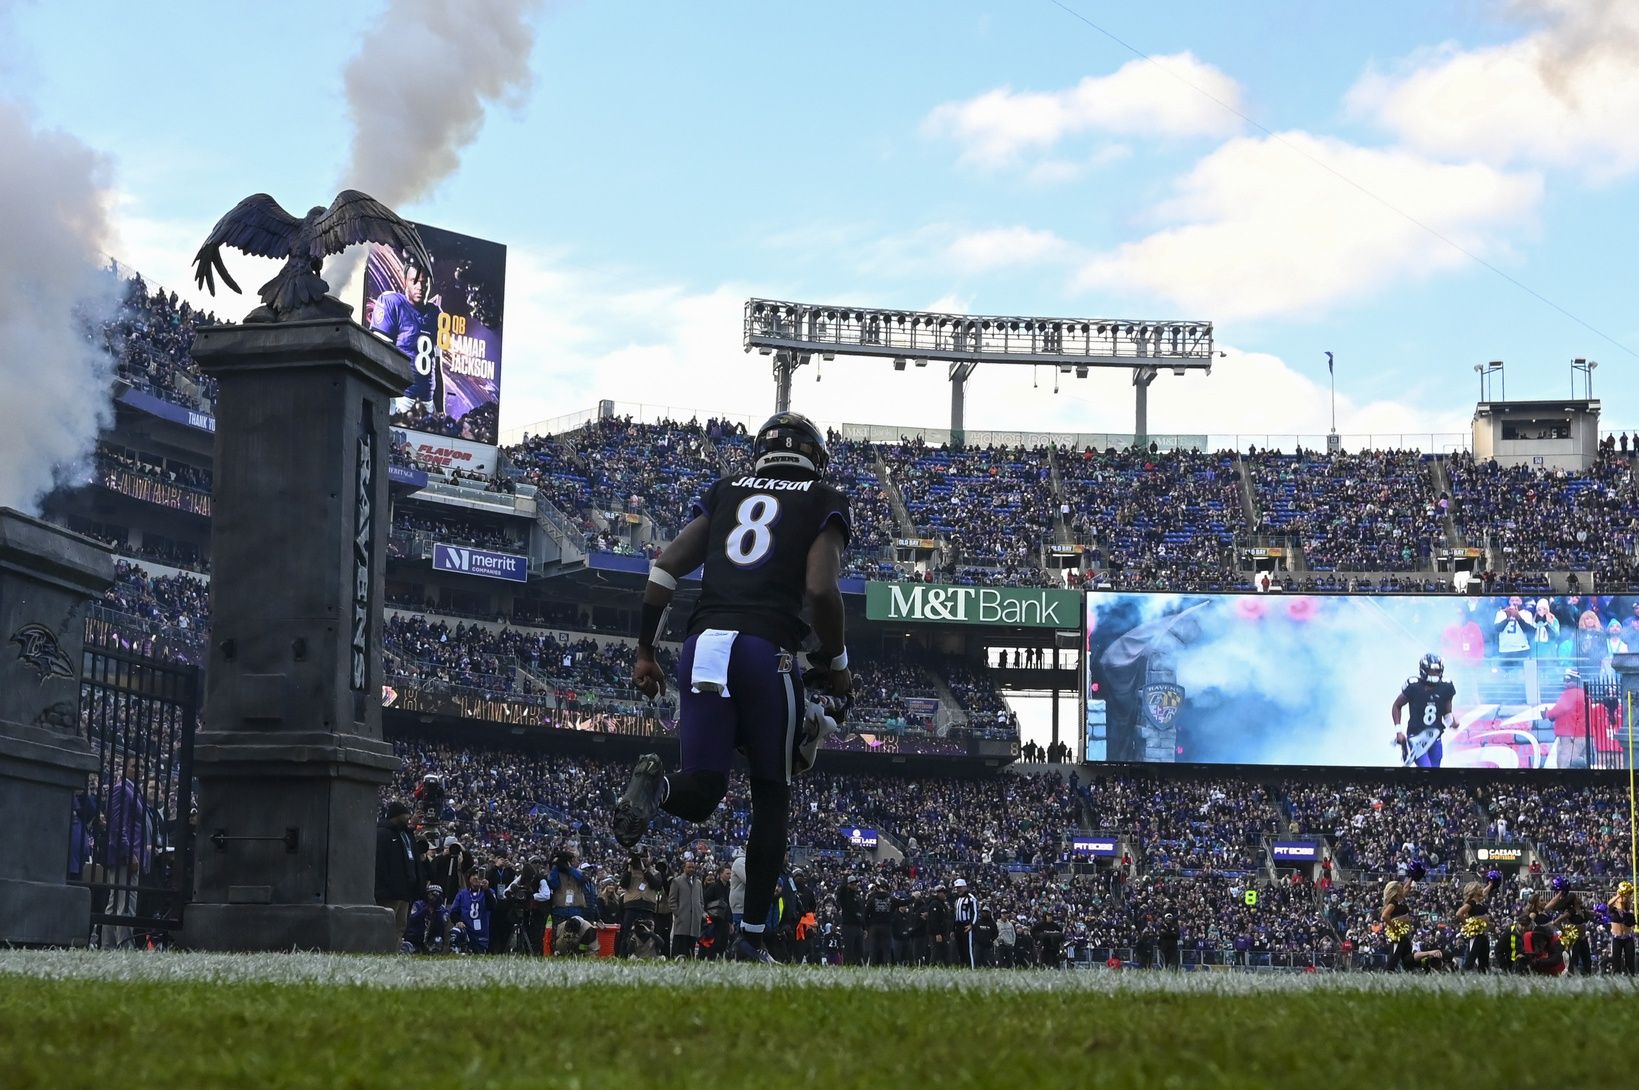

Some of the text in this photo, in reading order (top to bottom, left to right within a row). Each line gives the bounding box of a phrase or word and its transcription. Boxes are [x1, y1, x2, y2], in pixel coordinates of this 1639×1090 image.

[437, 312, 451, 350] 8
[452, 315, 466, 335] QB
[450, 334, 486, 358] LAMAR
[415, 335, 433, 375] 8
[450, 352, 495, 380] JACKSON
[189, 411, 208, 429] THANK
[786, 437, 792, 448] 8
[416, 453, 452, 465] ZONE
[418, 444, 472, 461] FLAVOR
[732, 476, 814, 492] JACKSON
[725, 494, 780, 565] 8
[472, 554, 516, 571] merritt
[472, 566, 501, 575] COMPANIES
[888, 585, 1060, 624] M&T Bank
[1423, 705, 1437, 726] 8
[1074, 842, 1114, 851] PIT BOSS
[1489, 849, 1521, 857] CAESARS
[1245, 890, 1257, 905] 8
